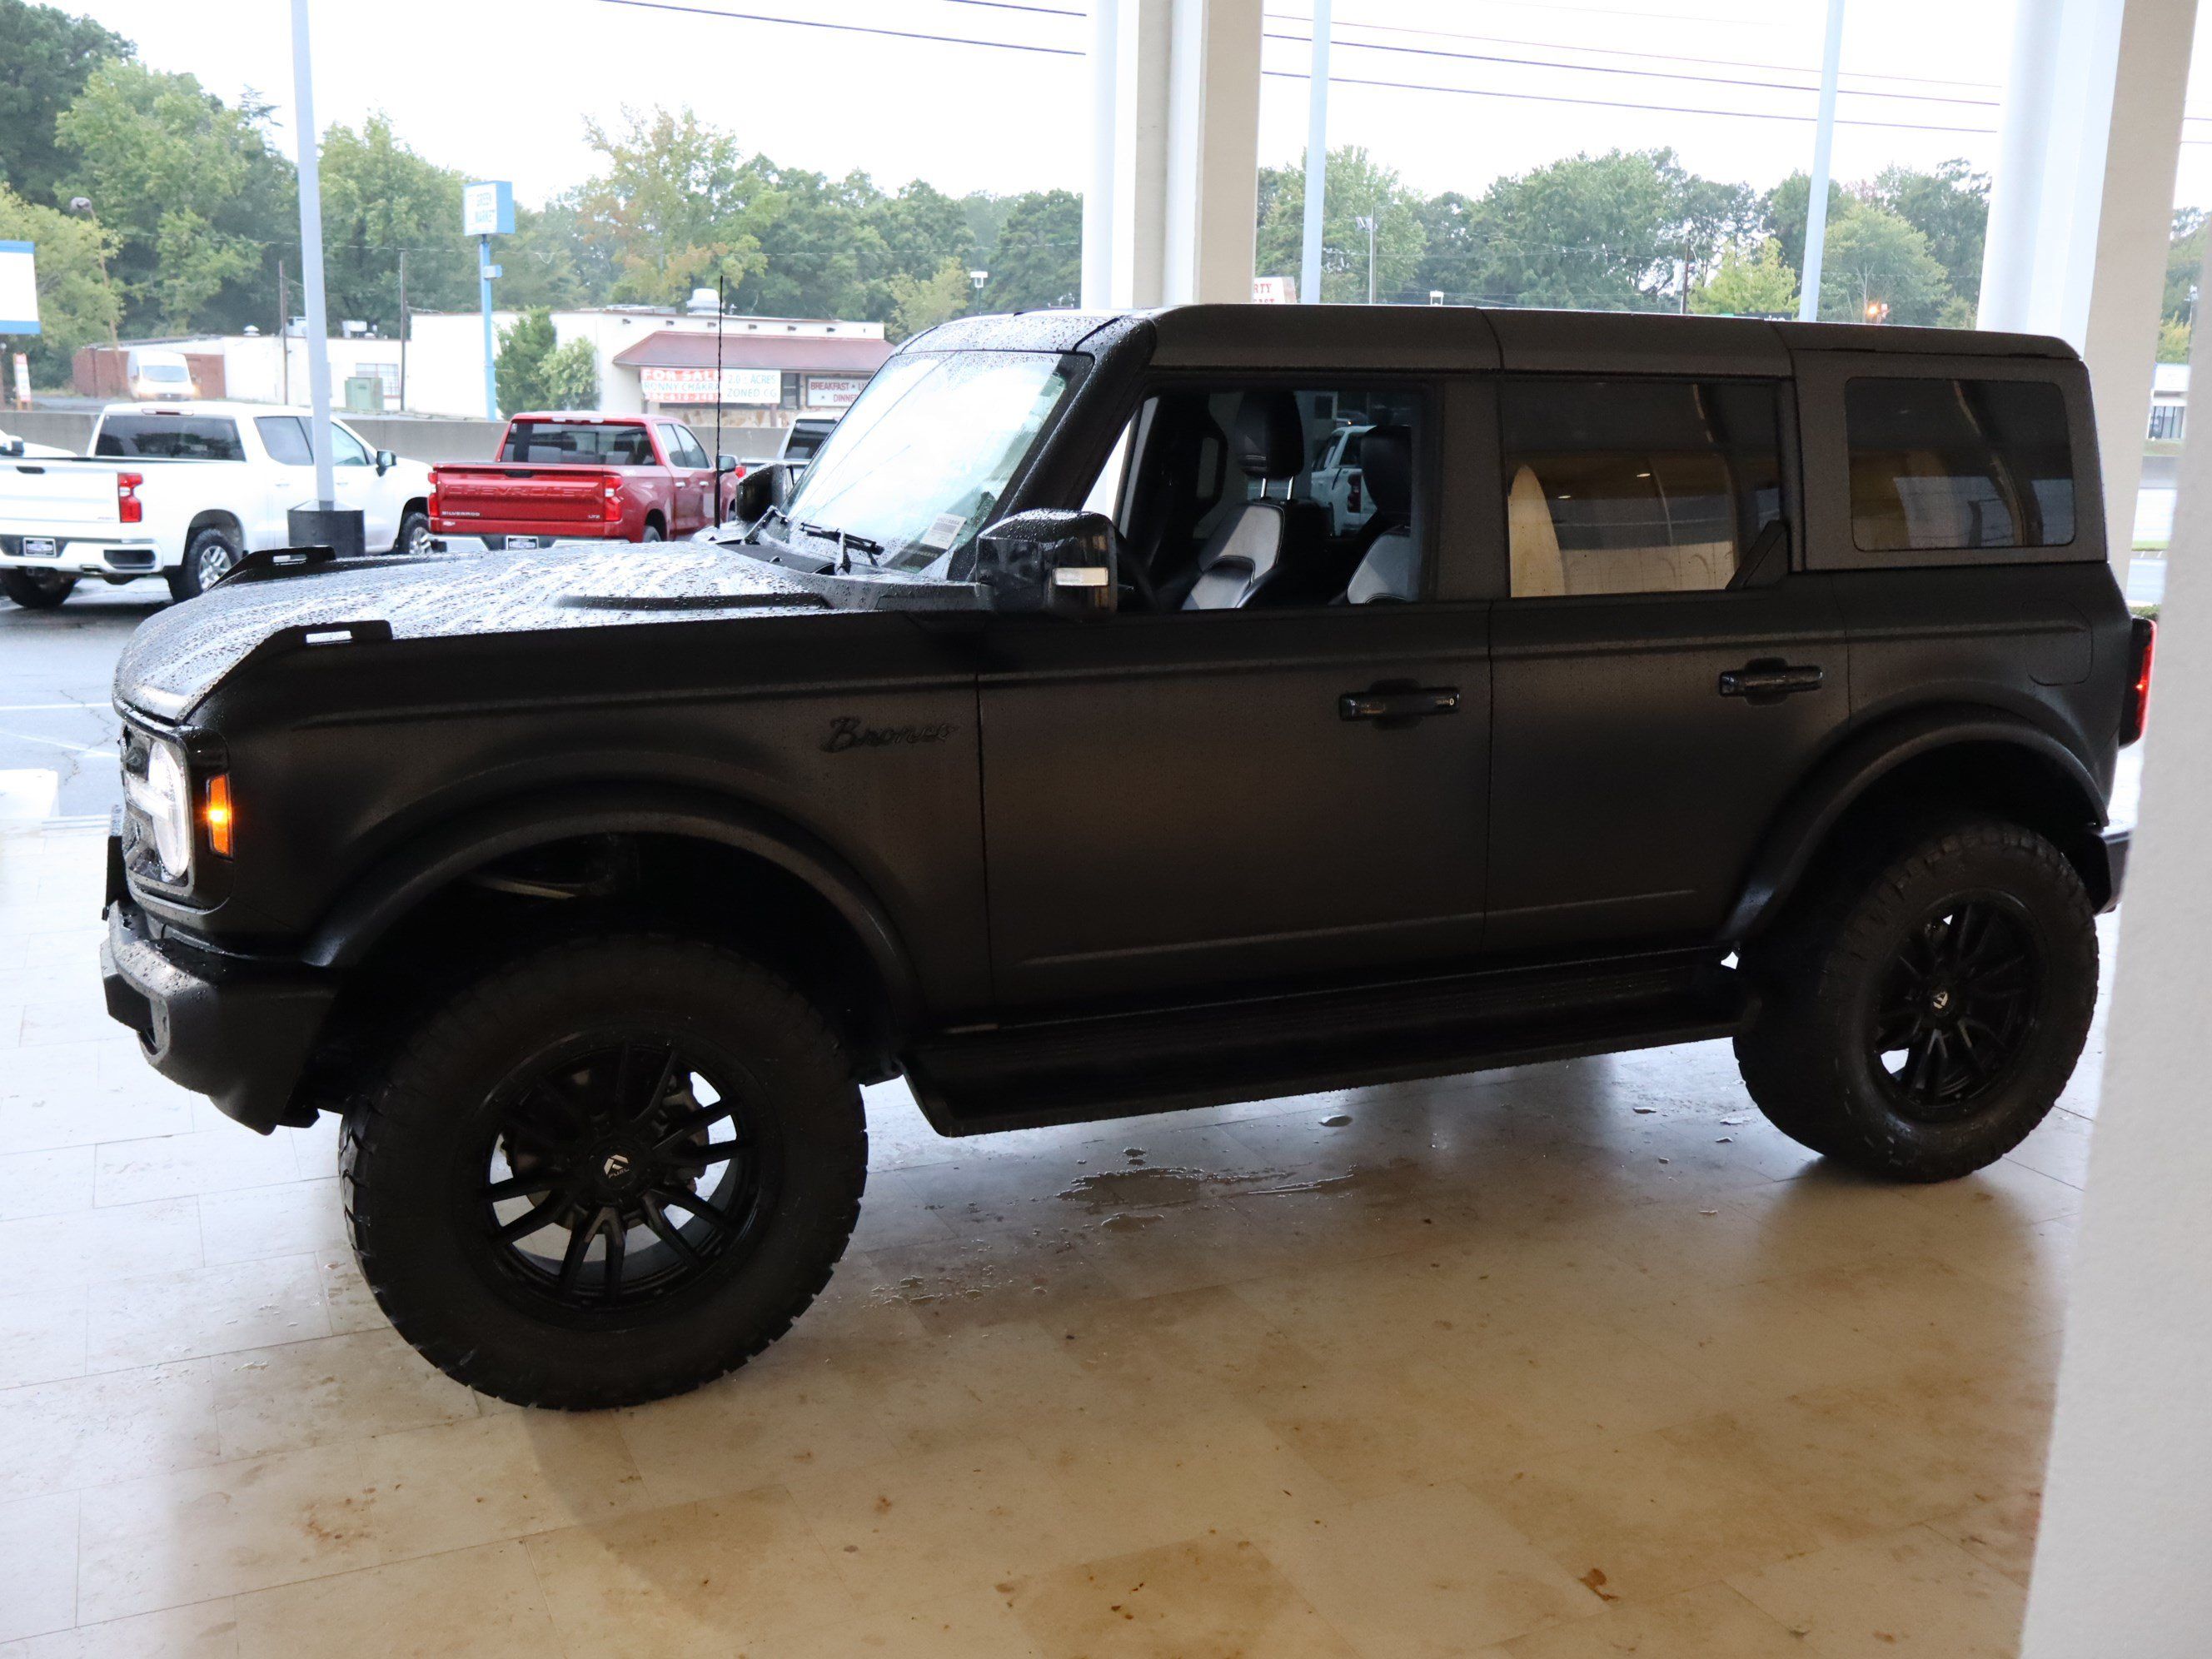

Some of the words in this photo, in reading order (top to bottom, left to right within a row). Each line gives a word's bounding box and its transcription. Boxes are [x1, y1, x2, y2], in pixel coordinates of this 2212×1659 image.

[1253, 284, 1272, 293] RTY
[645, 369, 676, 380] FOR
[750, 375, 776, 383] ACRES
[810, 381, 849, 391] BREAKFAST
[727, 388, 760, 398] ZONED
[833, 394, 858, 402] DINNE
[448, 485, 593, 497] CHEVROLET
[819, 715, 960, 754] Bronco
